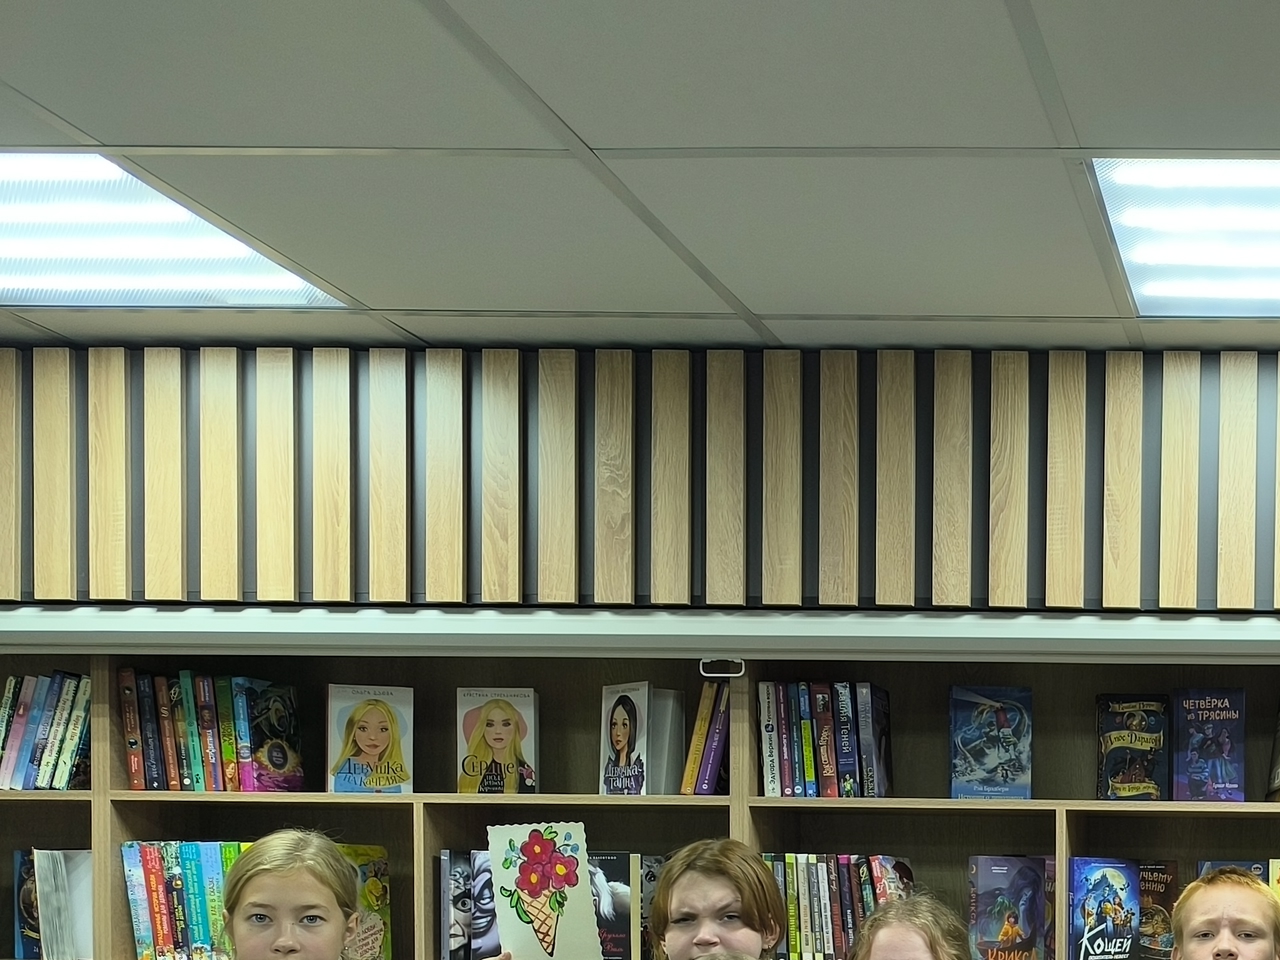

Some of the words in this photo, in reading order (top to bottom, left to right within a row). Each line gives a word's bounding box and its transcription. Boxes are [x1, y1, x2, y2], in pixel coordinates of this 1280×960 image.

[1182, 695, 1230, 709] ЧЕТВЁРКА
[1197, 709, 1239, 721] ТРЯСИНЫ
[840, 722, 852, 753] Теней
[461, 754, 514, 779] СЕРДЦЕ
[1140, 871, 1173, 884] учьему
[1140, 882, 1166, 893] ению
